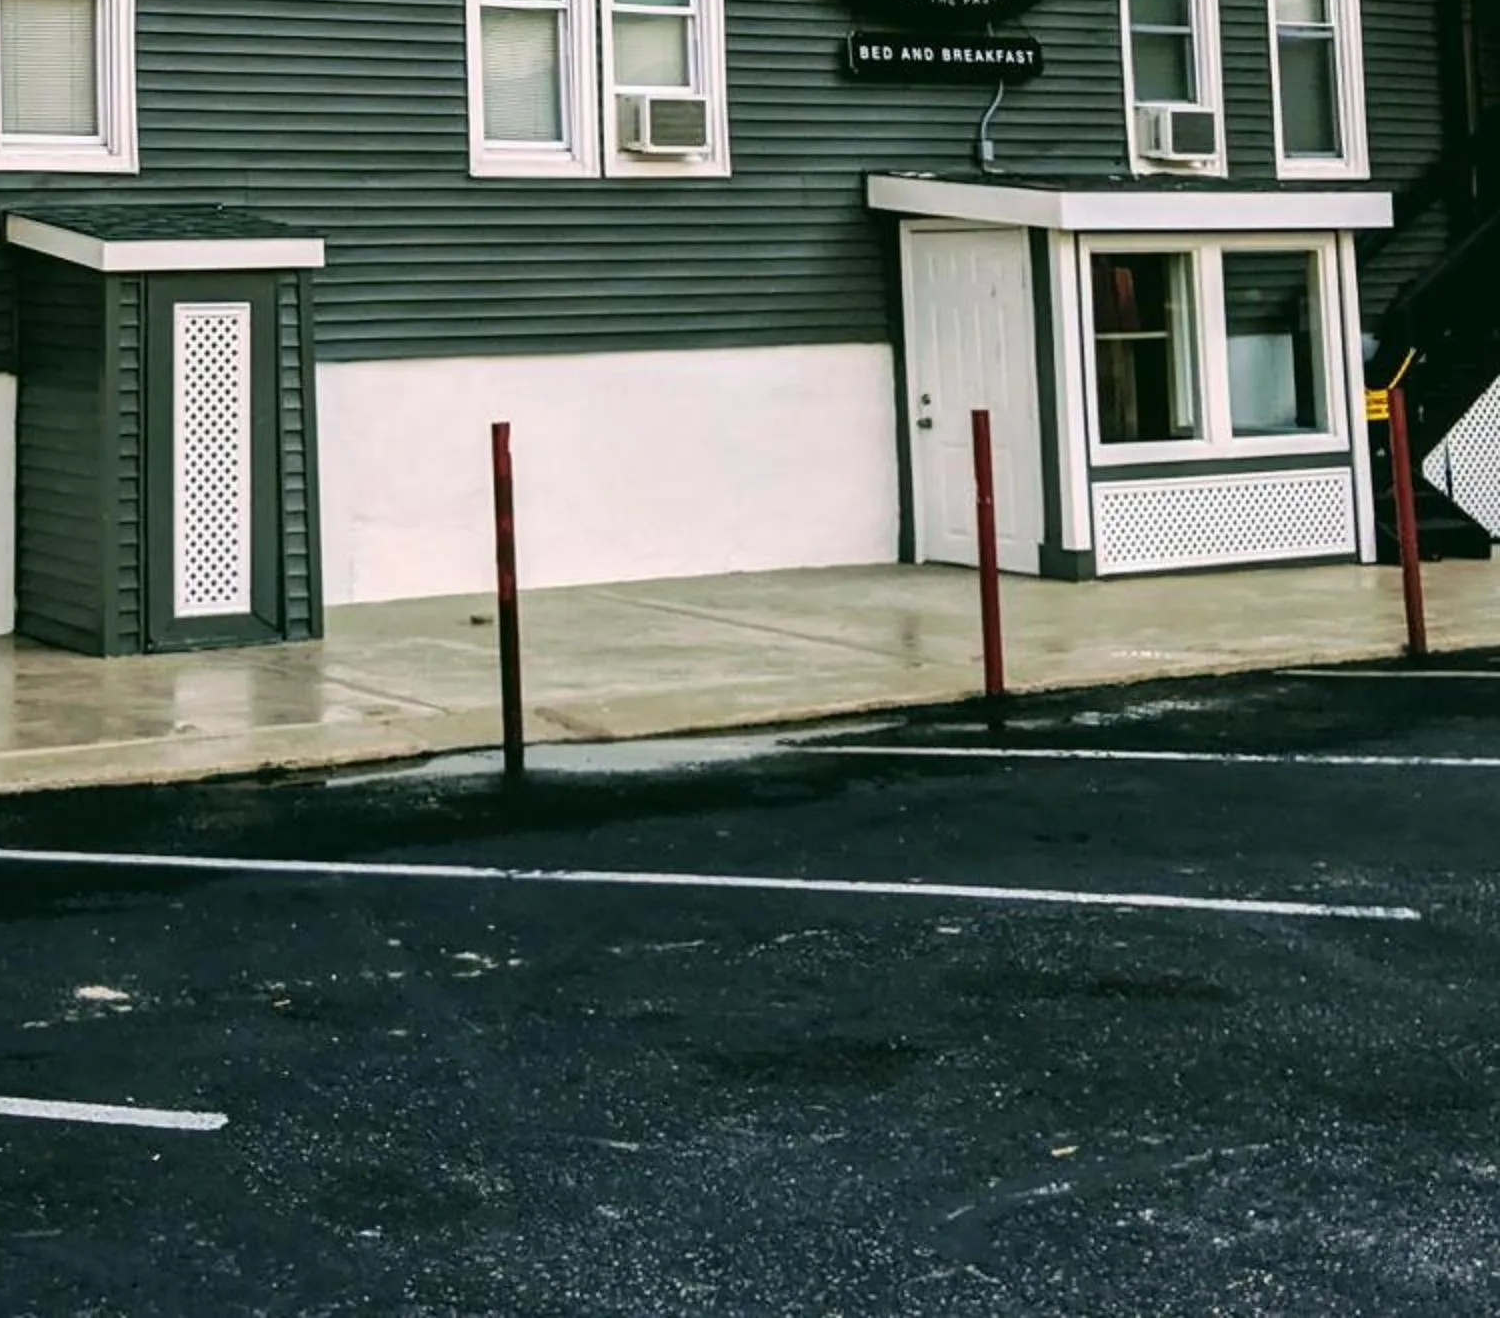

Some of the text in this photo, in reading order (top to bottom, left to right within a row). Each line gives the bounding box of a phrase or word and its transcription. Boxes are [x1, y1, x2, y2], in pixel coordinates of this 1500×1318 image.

[859, 44, 1035, 65] BED AND BREAKFAST
